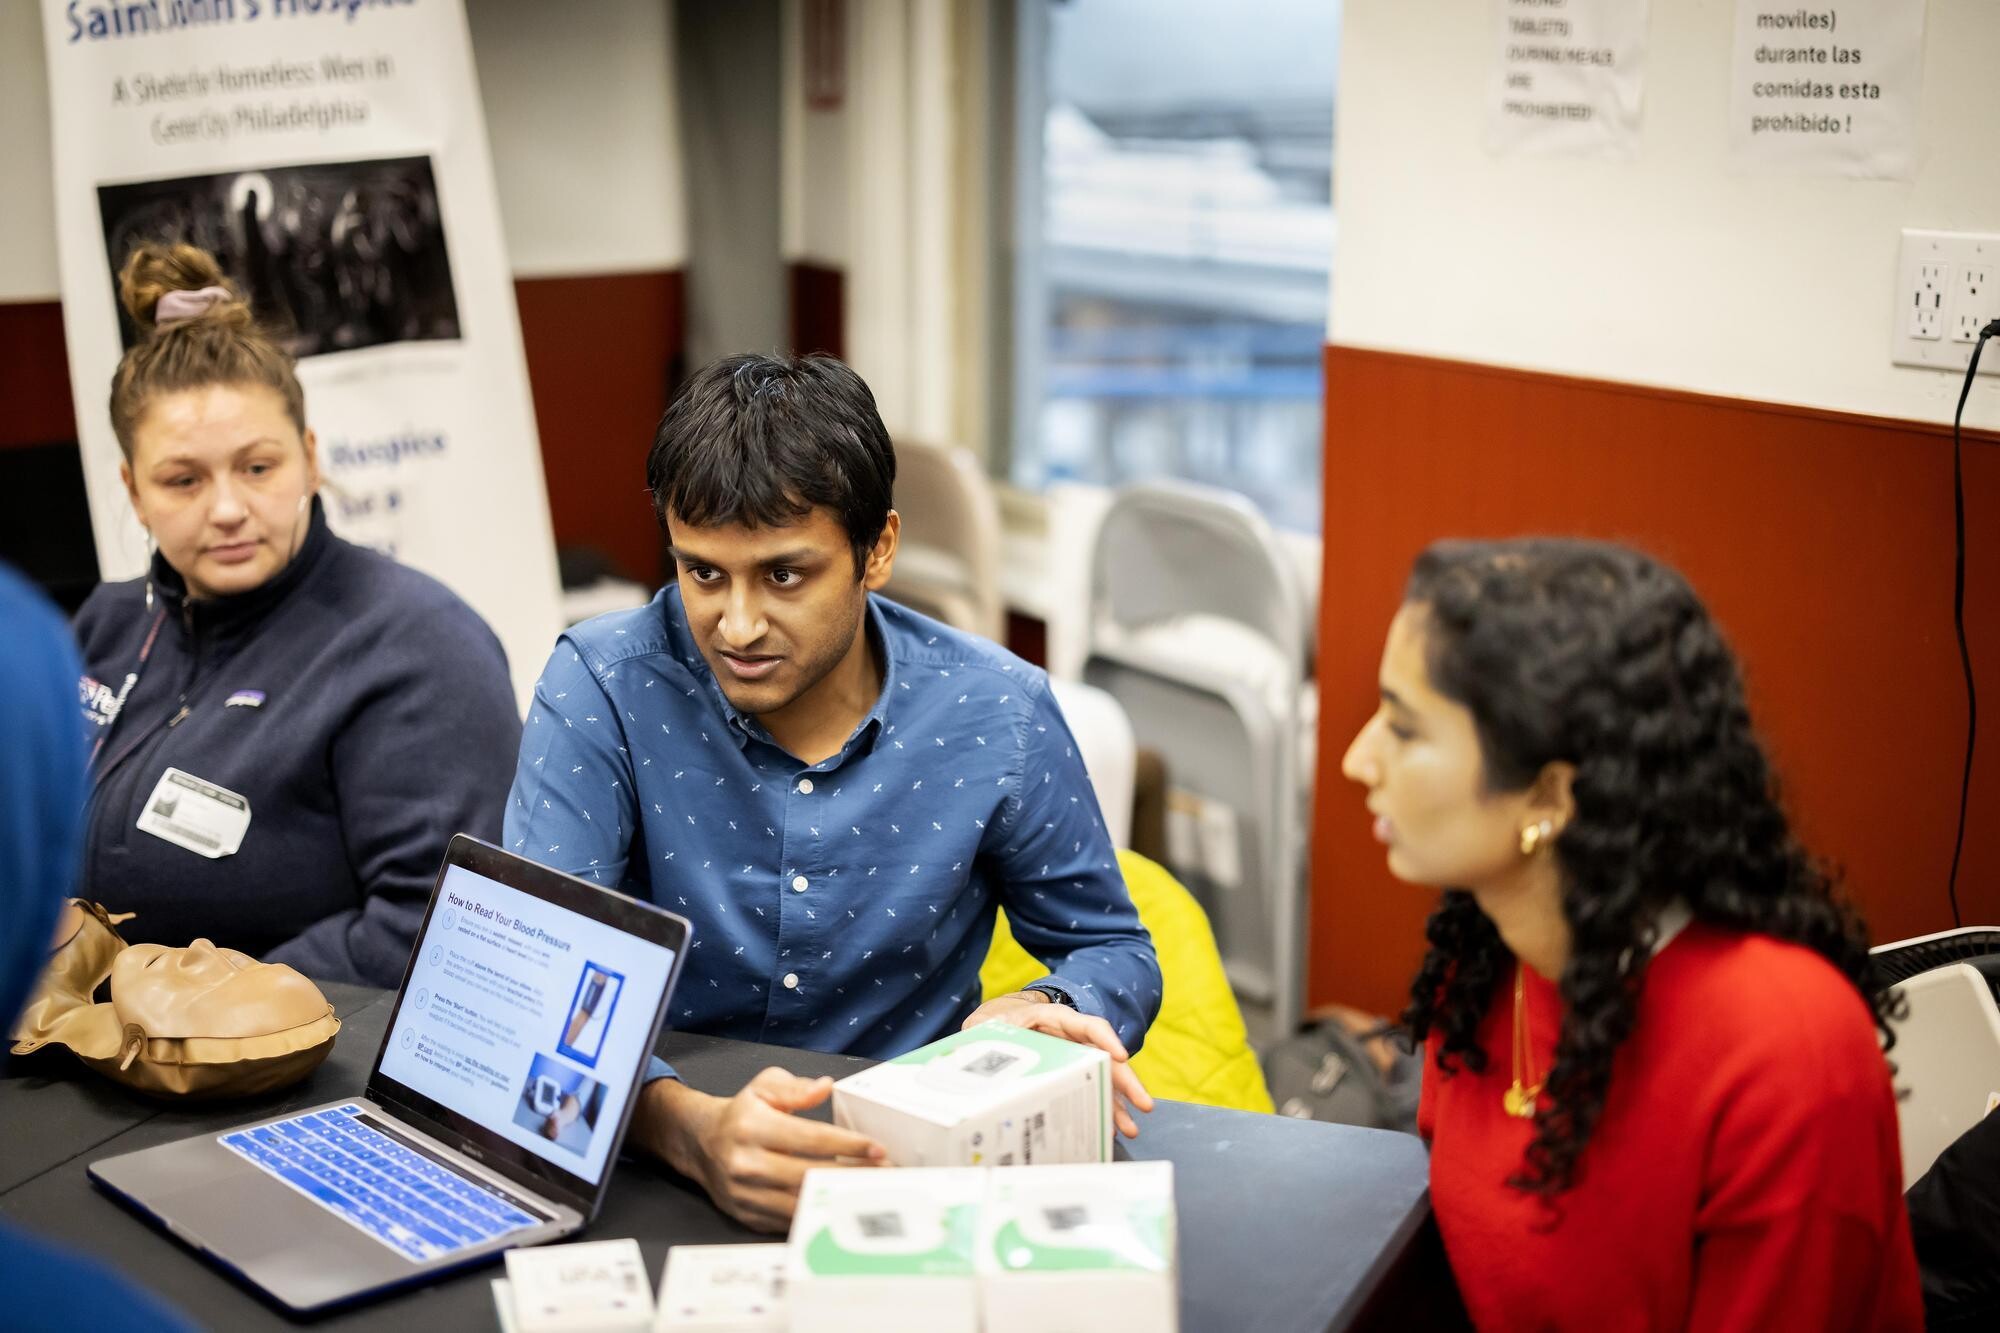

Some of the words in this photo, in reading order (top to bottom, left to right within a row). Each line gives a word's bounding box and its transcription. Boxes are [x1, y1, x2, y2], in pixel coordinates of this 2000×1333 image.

[1756, 9, 1836, 33] moviles)
[1754, 44, 1827, 64] durante
[1832, 44, 1862, 64] las
[1752, 79, 1834, 98] comidas
[1839, 82, 1880, 99] esta
[1752, 113, 1840, 135] prohibido
[447, 892, 466, 907] How
[464, 900, 474, 911] to
[473, 903, 495, 919] Read
[493, 911, 514, 928] Your
[512, 919, 537, 937] Blood
[536, 929, 573, 952] Pressure
